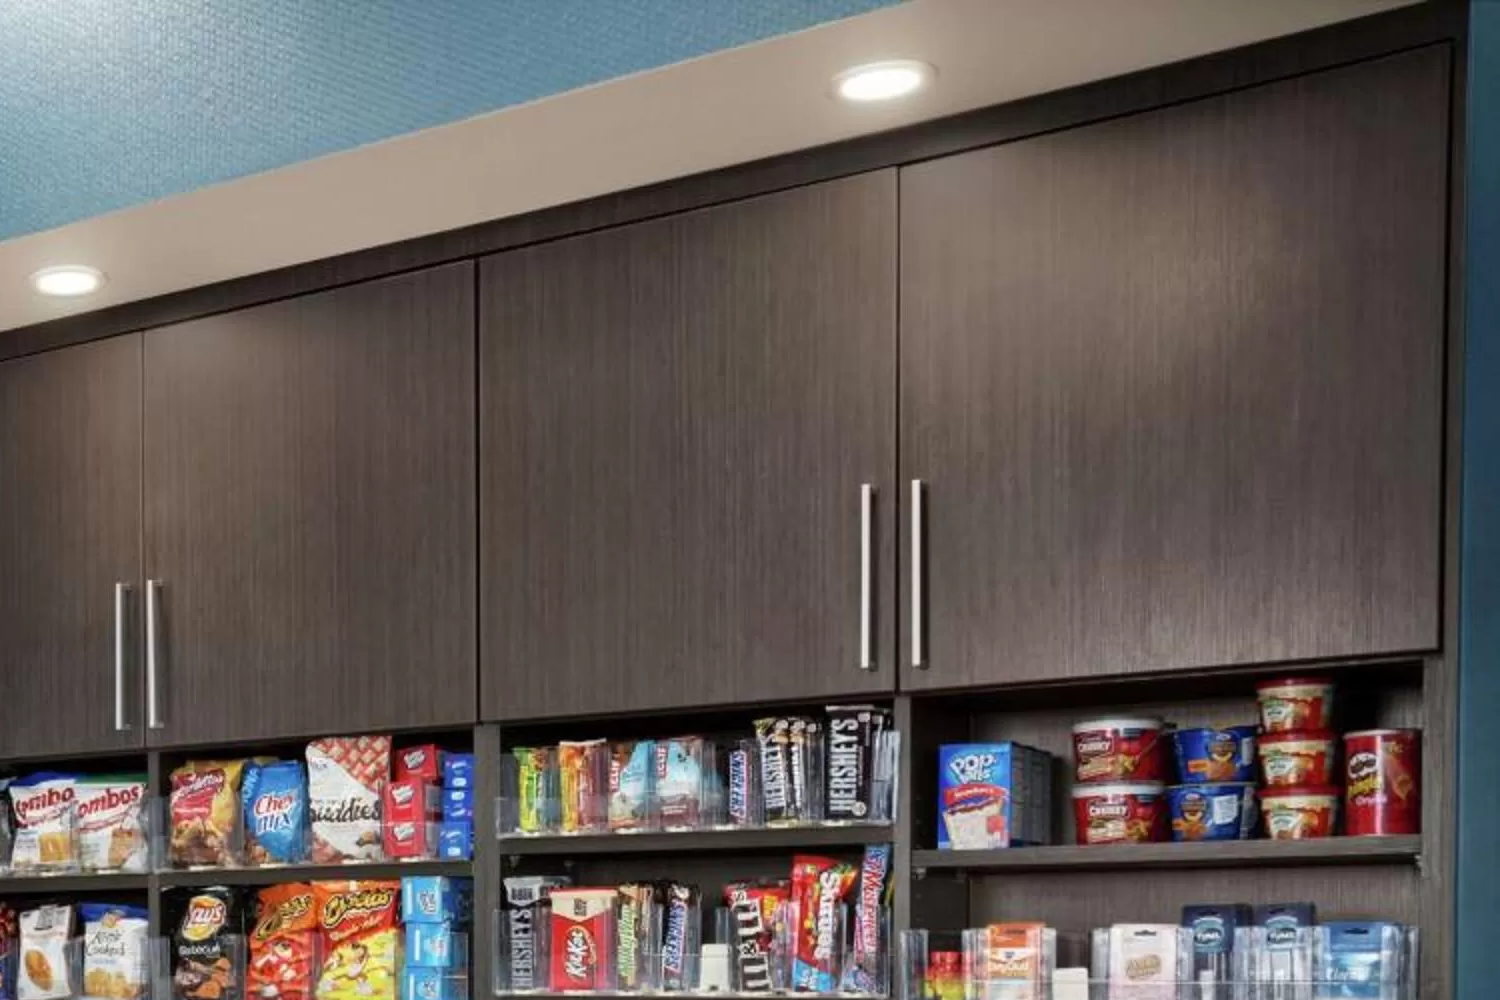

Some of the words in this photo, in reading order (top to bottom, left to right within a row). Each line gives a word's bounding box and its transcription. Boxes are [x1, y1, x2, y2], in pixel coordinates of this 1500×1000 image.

[77, 785, 140, 818] ombos
[830, 718, 858, 812] HERSHEY'S
[510, 908, 533, 988] HERSHEY'S
